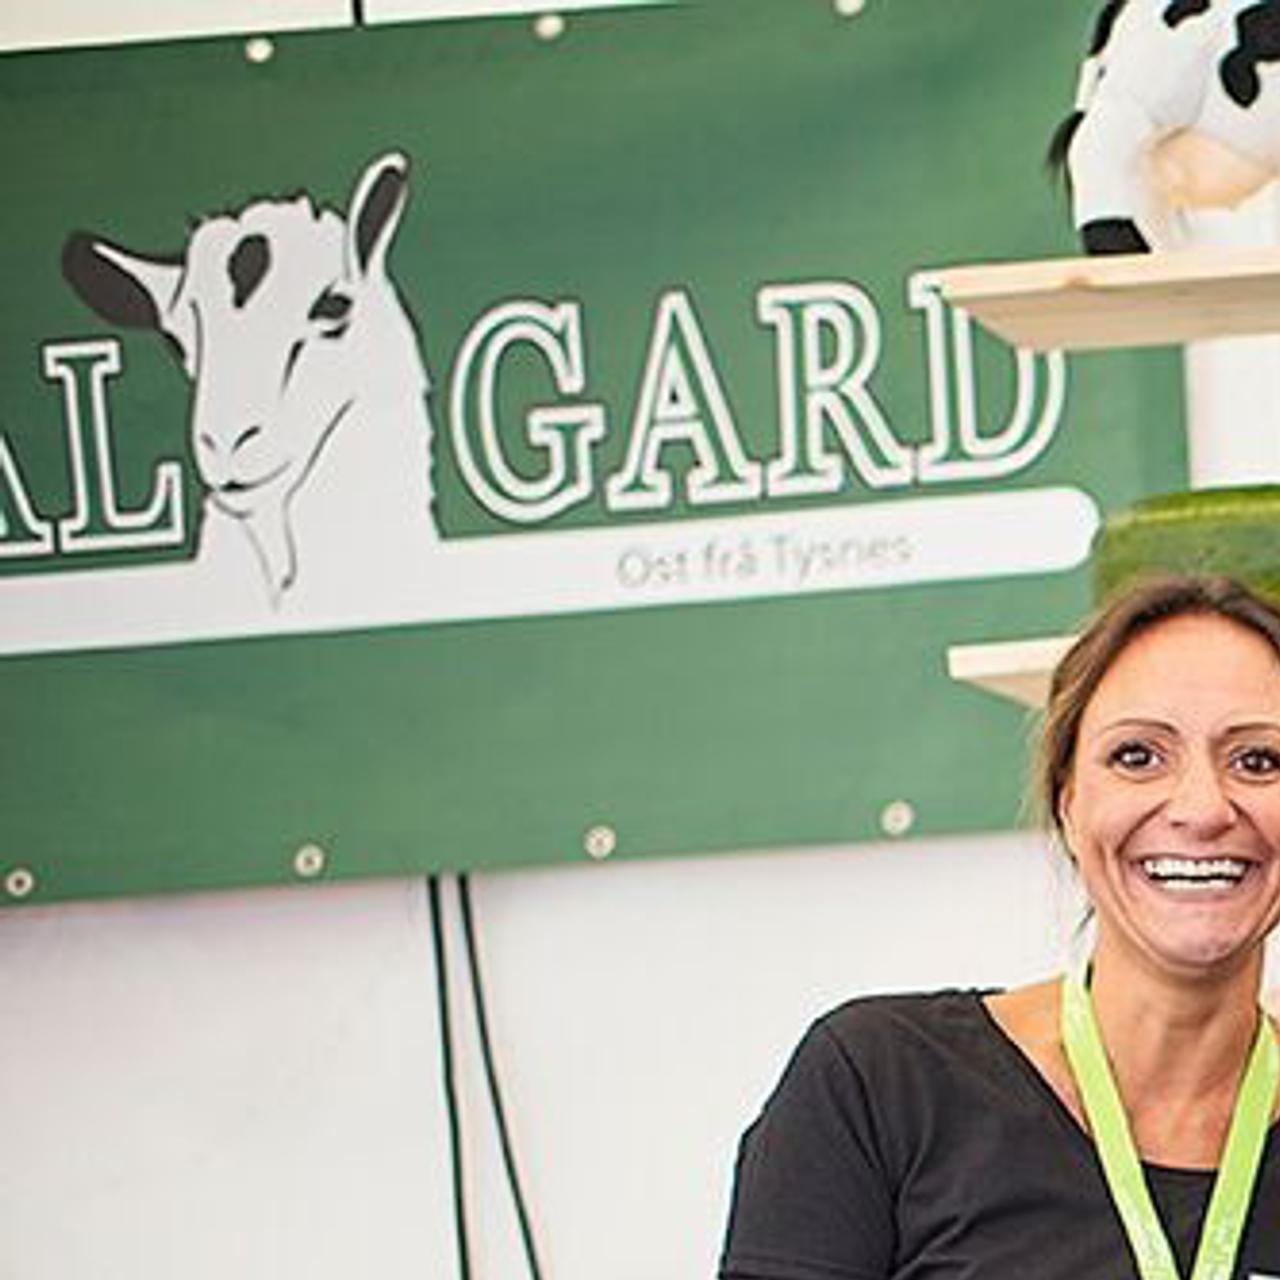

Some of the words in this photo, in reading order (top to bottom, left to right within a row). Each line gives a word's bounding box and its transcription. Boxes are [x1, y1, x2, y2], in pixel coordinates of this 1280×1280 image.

[450, 271, 1068, 523] GARD
[616, 543, 689, 589] Ost
[769, 530, 916, 581] Tysnes
